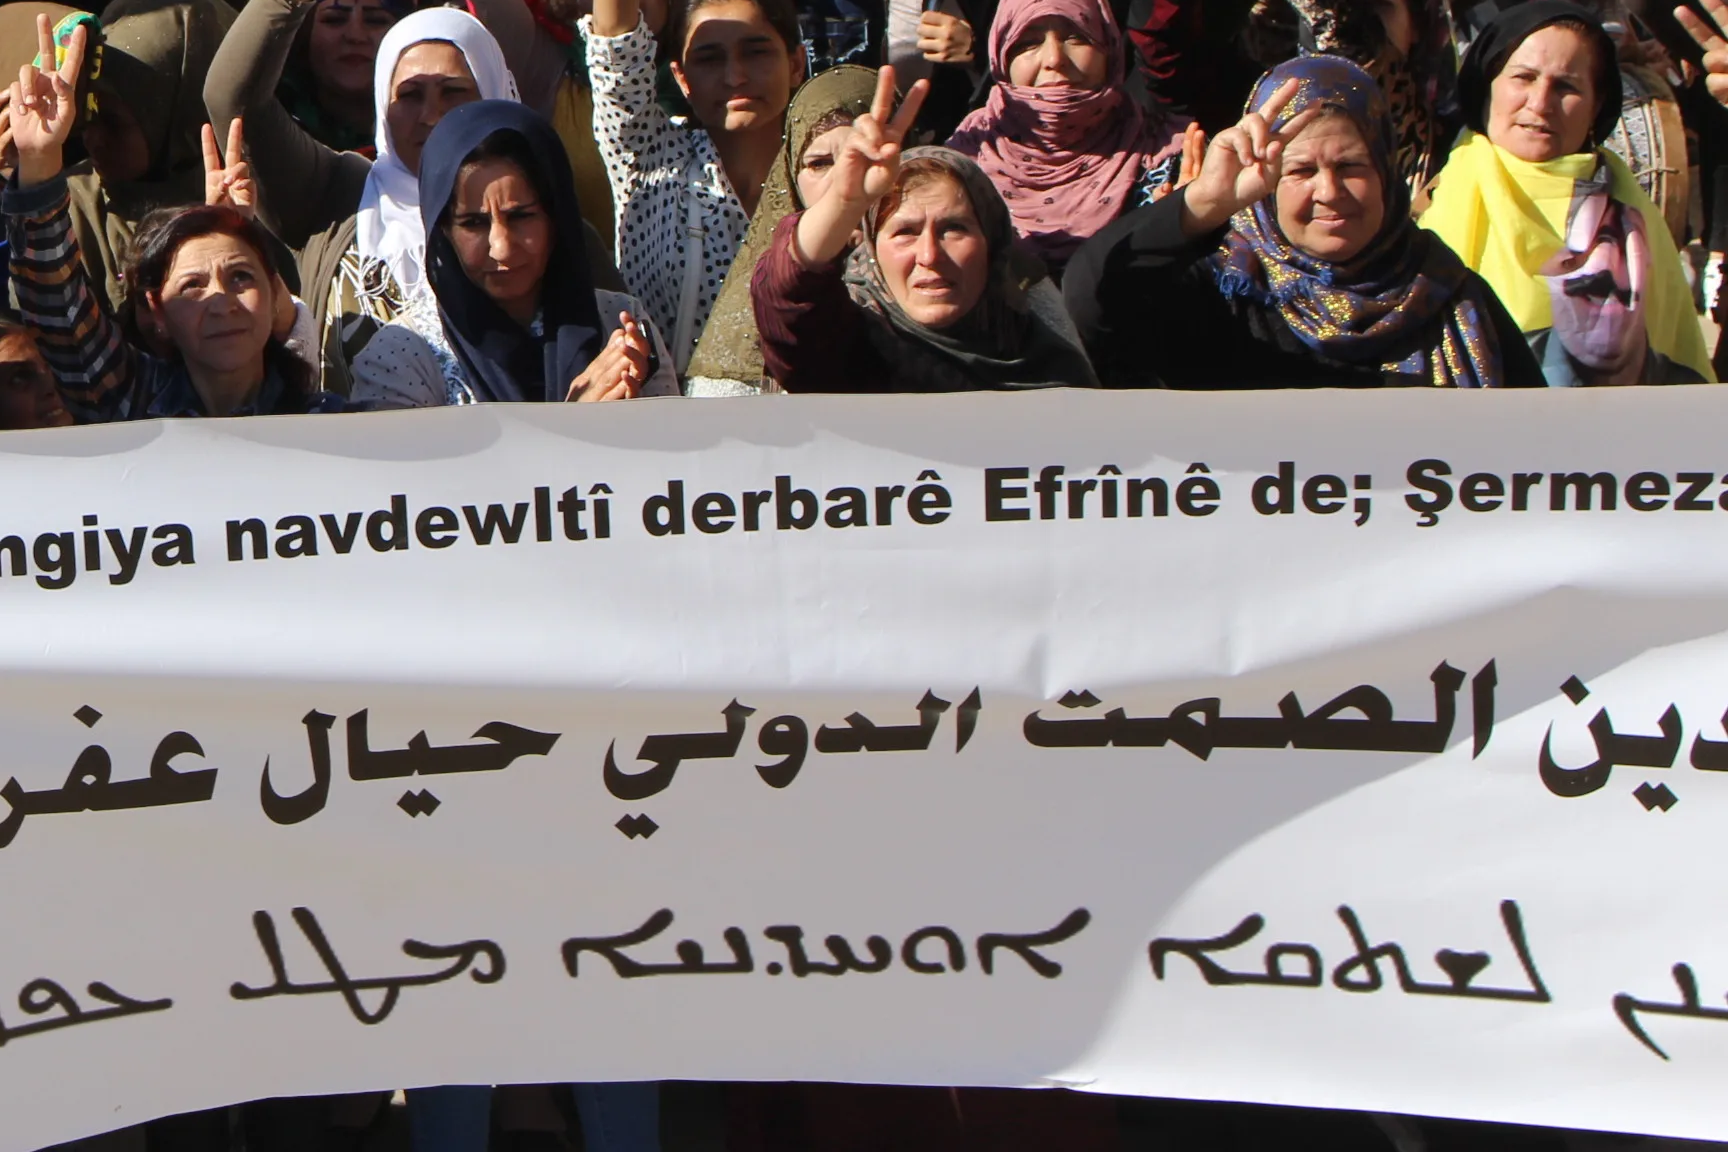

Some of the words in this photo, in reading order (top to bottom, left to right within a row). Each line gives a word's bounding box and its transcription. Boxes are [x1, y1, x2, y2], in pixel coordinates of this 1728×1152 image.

[226, 483, 613, 562] navdewltî
[642, 469, 952, 537] derbarê
[984, 462, 1221, 522] Efrînê
[1251, 461, 1372, 527] de;
[1404, 458, 1728, 527] Şermez
[603, 686, 982, 840] الدولي
[1023, 658, 1498, 762] الصمت
[260, 708, 562, 825] حيال
